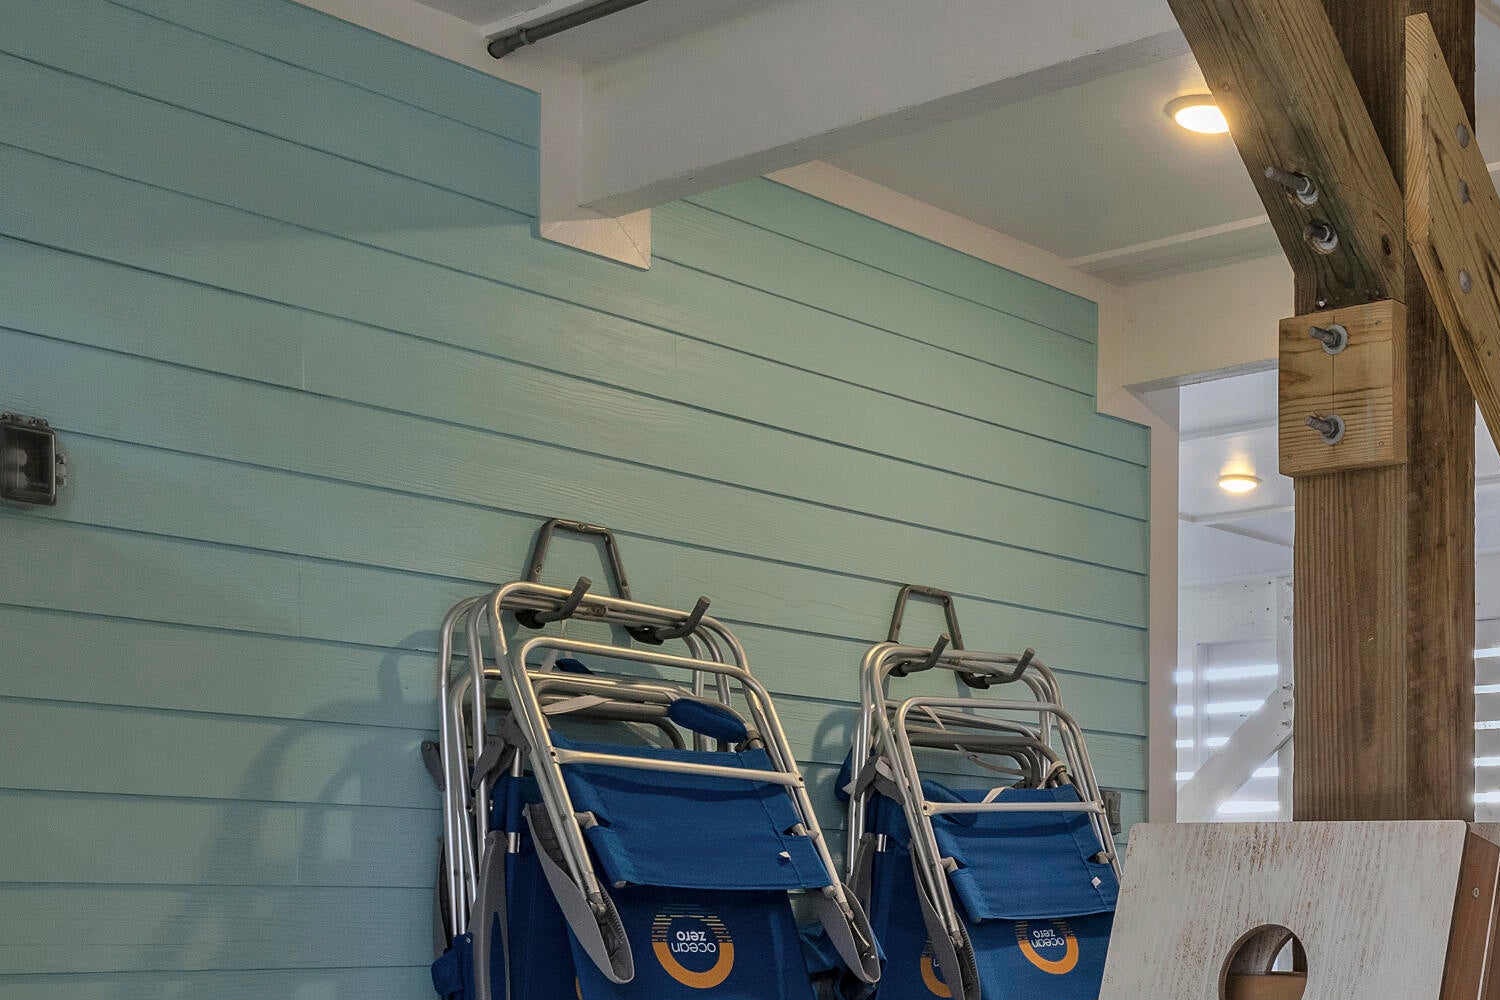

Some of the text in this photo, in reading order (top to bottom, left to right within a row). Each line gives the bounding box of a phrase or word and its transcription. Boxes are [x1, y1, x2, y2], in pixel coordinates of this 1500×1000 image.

[676, 931, 707, 941] zero
[1032, 929, 1056, 938] zero
[671, 942, 716, 953] ocean
[1031, 937, 1065, 948] ocean
